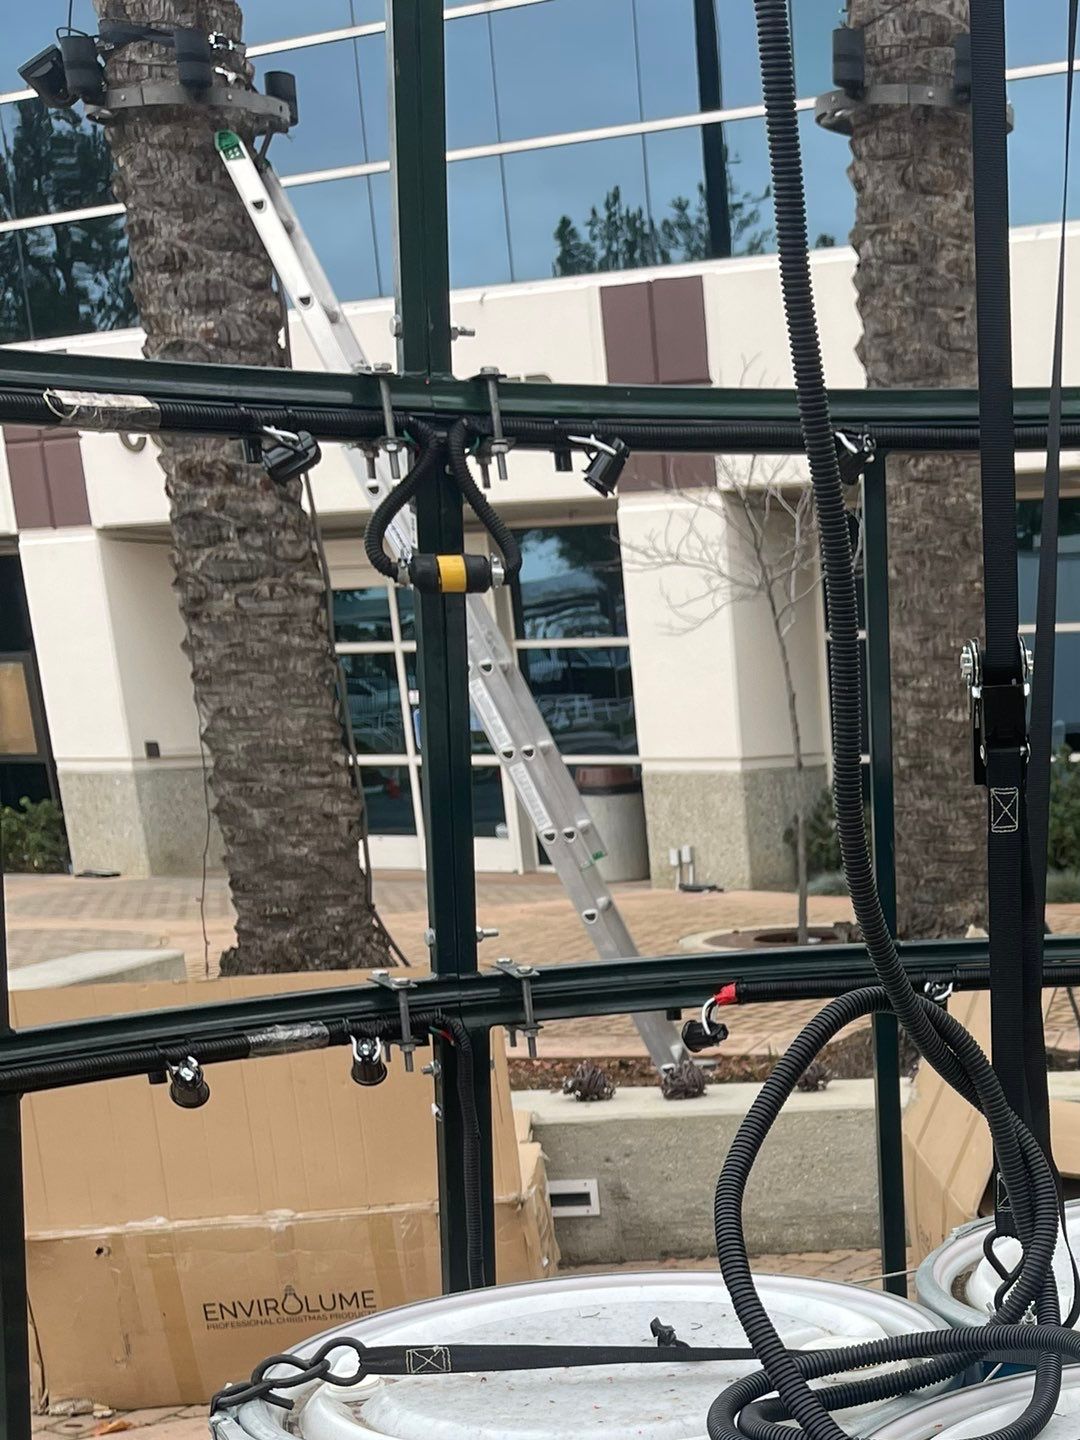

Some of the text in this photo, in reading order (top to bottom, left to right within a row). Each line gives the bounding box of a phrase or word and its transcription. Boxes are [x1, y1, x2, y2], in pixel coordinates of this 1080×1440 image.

[203, 1285, 376, 1321] ENVIROLUME
[206, 1319, 277, 1330] PROFESSIONAL
[277, 1314, 328, 1324] CHRISTMAS
